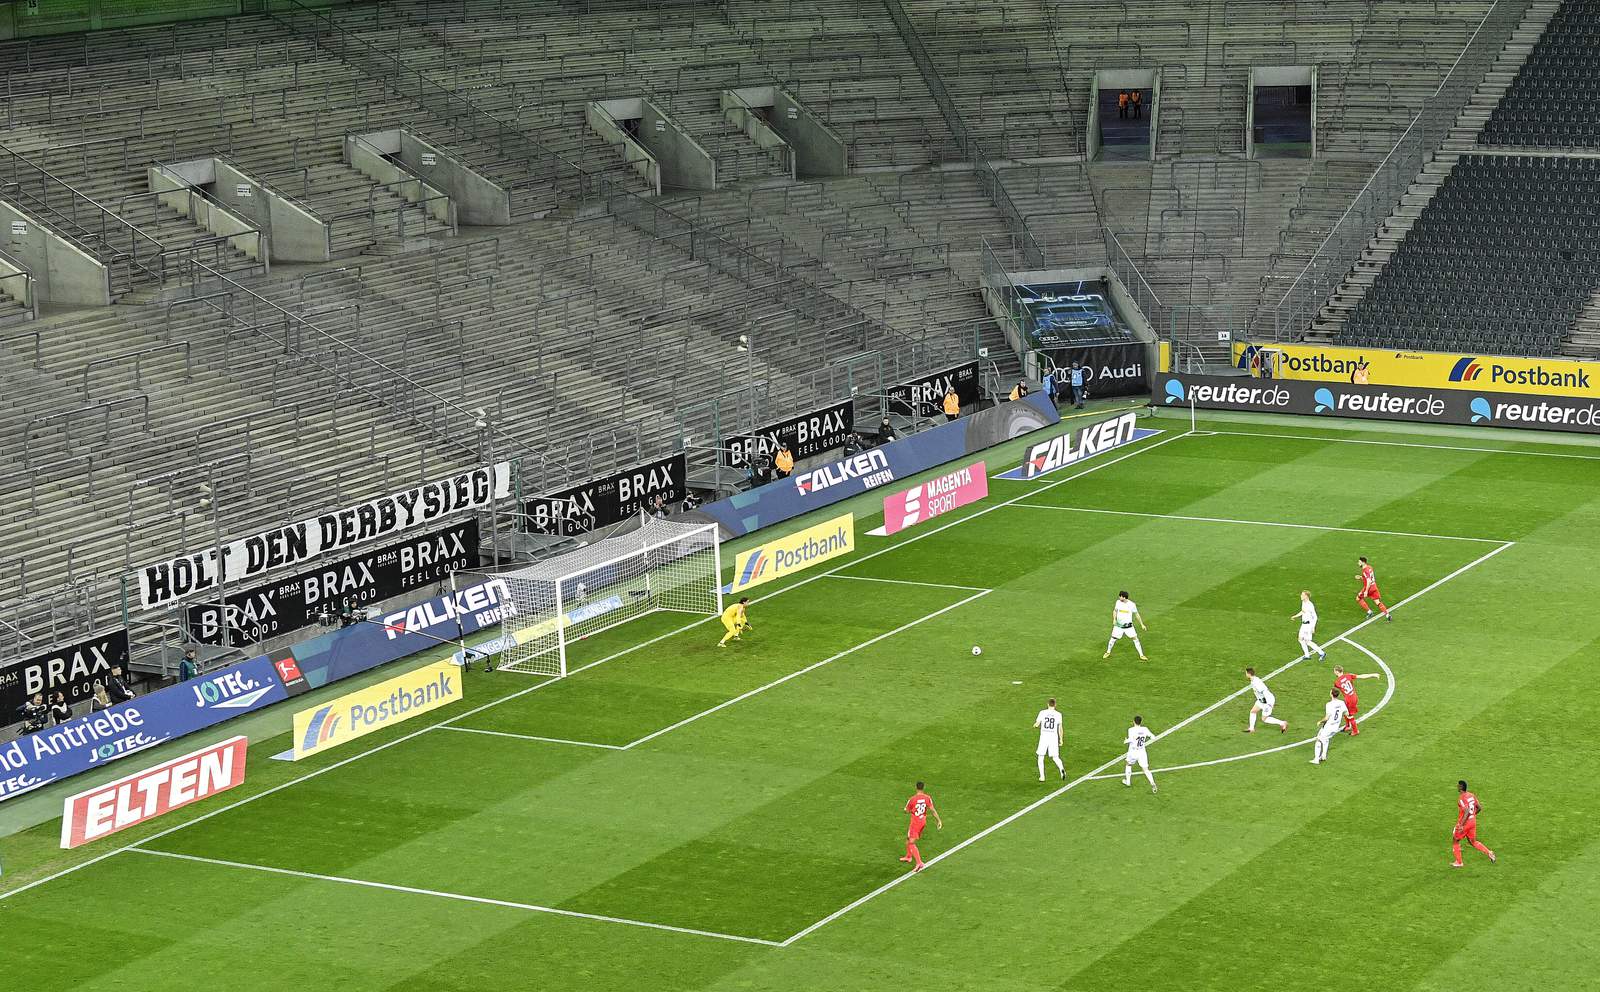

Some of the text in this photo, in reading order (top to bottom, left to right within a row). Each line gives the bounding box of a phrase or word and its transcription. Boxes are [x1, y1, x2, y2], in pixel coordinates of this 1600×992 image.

[1099, 364, 1142, 380] Audi
[1492, 365, 1590, 388] Postbank
[1188, 384, 1290, 406] reuter.de
[1338, 392, 1445, 415] reuter.de
[797, 408, 845, 443] BRAX
[1494, 402, 1600, 426] reuter.de
[798, 433, 846, 456] FEEL GOOD
[1026, 412, 1137, 478] FALKEN
[618, 463, 674, 503] BRAX
[796, 450, 889, 496] FALKEN
[863, 468, 894, 490] REIFEN
[927, 468, 972, 499] MAGENTA
[620, 489, 675, 516] FEE GOD
[927, 491, 957, 518] SPORT
[145, 463, 496, 607] HOLT DEN DERBYSIEG
[775, 527, 847, 572] Postbank
[377, 551, 397, 564] BRAX
[400, 529, 466, 573] BRAX
[279, 581, 300, 595] BRAX
[303, 558, 376, 605] BRAX
[402, 571, 430, 588] FEEL
[202, 589, 277, 638] BRAX
[383, 579, 511, 641] FALKEN
[25, 642, 111, 696] BRAX
[350, 671, 453, 732] Postbank
[1334, 709, 1340, 721] 6
[32, 707, 144, 760] Antriebe
[1044, 717, 1055, 730] 28
[85, 746, 234, 840] ELTEN
[915, 803, 927, 817] 38
